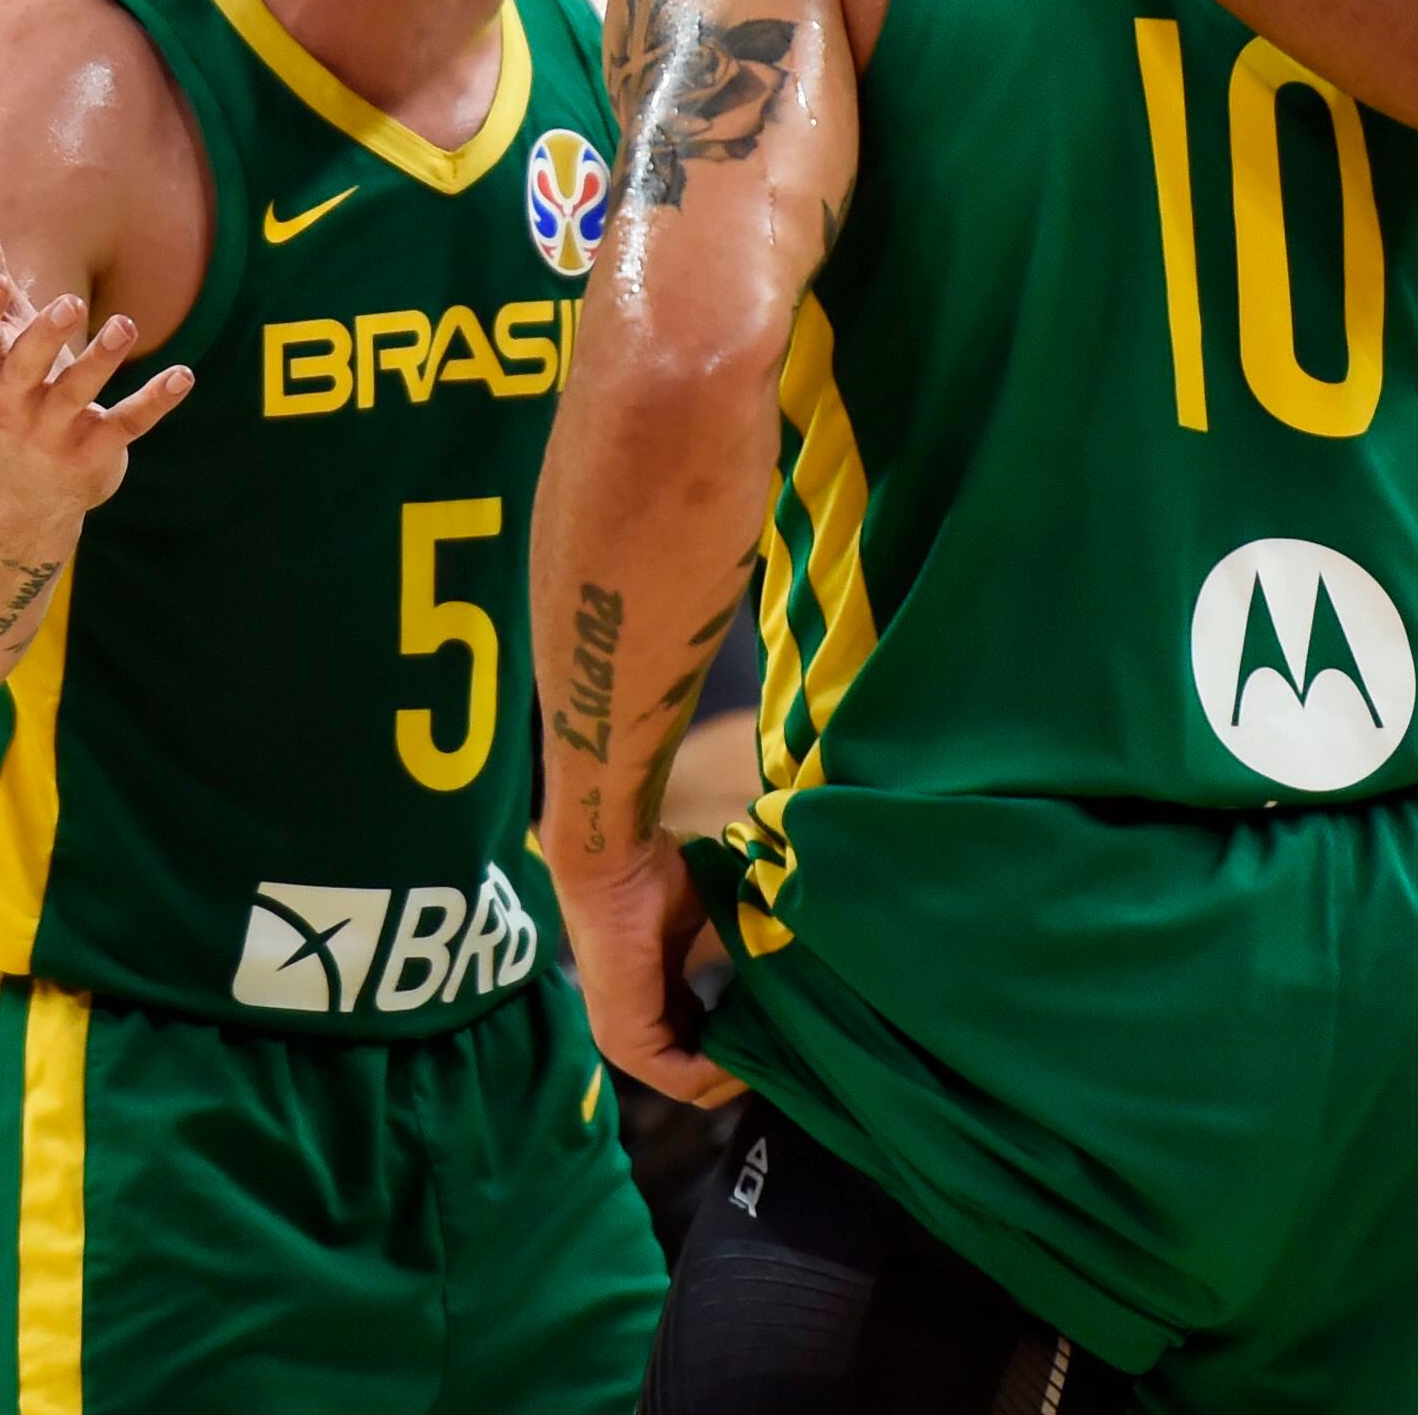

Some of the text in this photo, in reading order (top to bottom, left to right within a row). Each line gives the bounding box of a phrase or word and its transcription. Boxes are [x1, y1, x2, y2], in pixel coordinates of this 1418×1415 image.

[261, 298, 584, 419] BRASI
[1134, 17, 1387, 438] 10
[395, 496, 503, 792] 5
